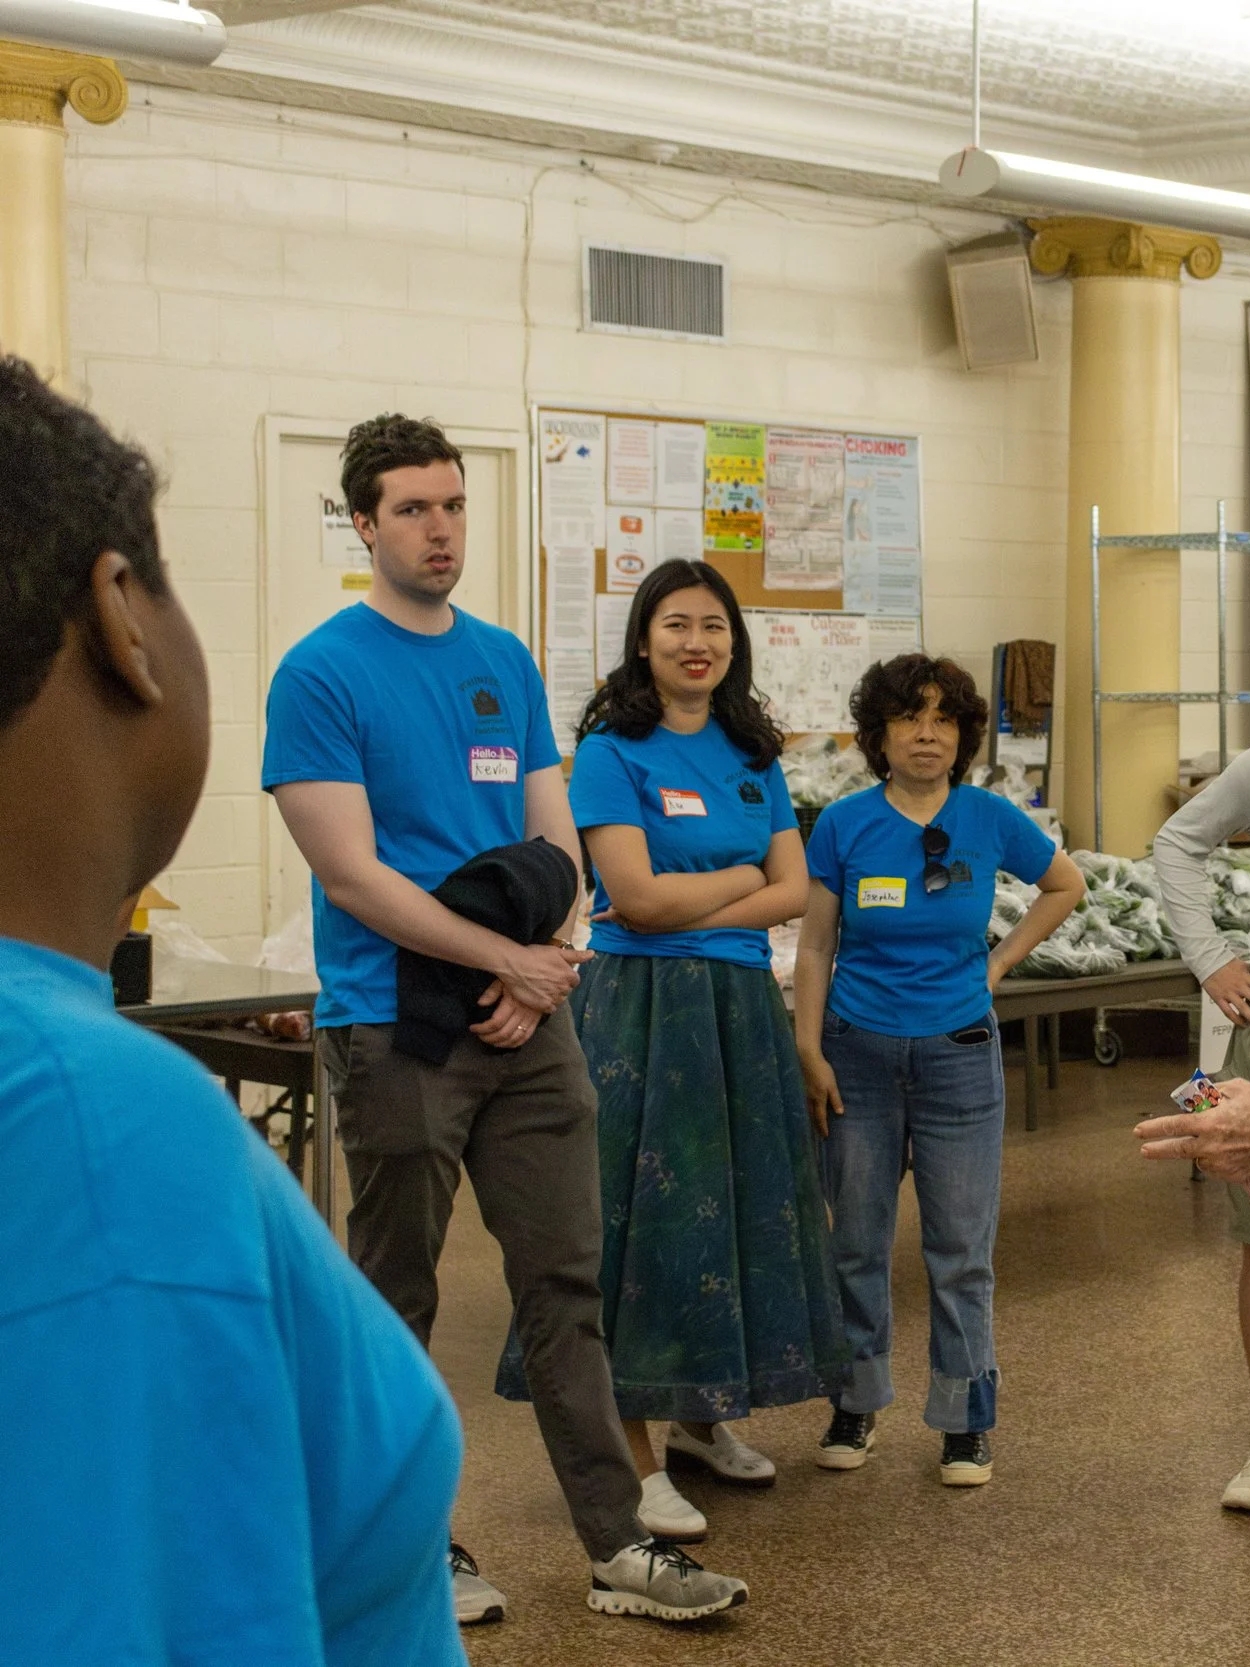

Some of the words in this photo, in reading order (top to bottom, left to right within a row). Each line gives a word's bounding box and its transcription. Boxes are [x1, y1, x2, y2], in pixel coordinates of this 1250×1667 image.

[845, 437, 907, 457] CHOKING
[471, 748, 497, 758] Hello
[474, 763, 508, 776] Kevin
